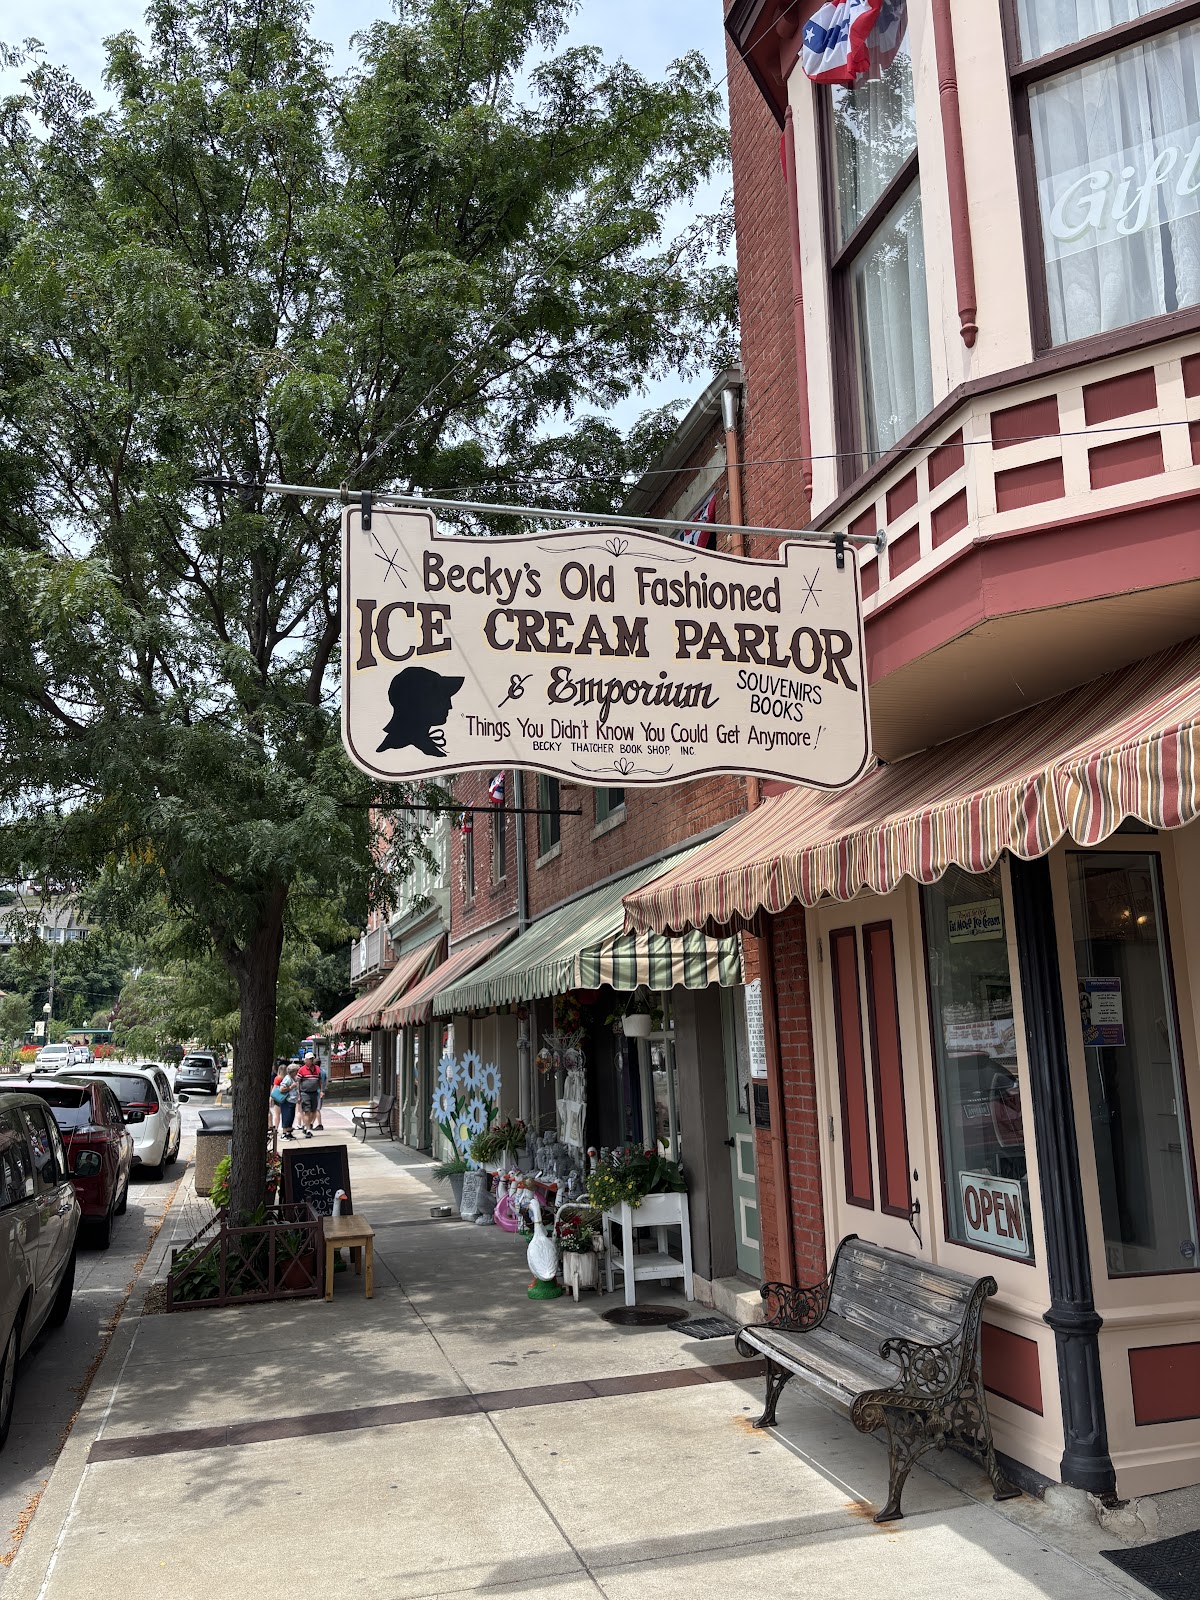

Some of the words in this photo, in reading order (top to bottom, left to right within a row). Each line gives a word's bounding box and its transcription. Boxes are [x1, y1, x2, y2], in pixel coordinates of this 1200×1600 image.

[423, 550, 541, 605] Becky's
[560, 561, 615, 603] Old
[634, 567, 781, 613] Fashioned
[356, 599, 452, 670] ICE
[483, 608, 649, 657] CREAM
[674, 620, 857, 692] PARLOR
[498, 674, 533, 708] &
[547, 666, 719, 723] Emporium
[737, 669, 822, 705] SOUVENIRS
[750, 694, 803, 722] BOOKS
[517, 717, 544, 738] You
[551, 718, 589, 740] Didn't
[596, 719, 634, 742] Know
[640, 721, 665, 742] You
[670, 722, 708, 744] Could
[716, 724, 740, 744] Get
[533, 741, 562, 752] BECKY
[571, 742, 614, 753] THATCHER
[620, 744, 643, 754] BOOK
[294, 1163, 327, 1178] Porch
[300, 1176, 330, 1187] Goose
[304, 1186, 332, 1197] Sale
[965, 1185, 1023, 1241] OPEN
